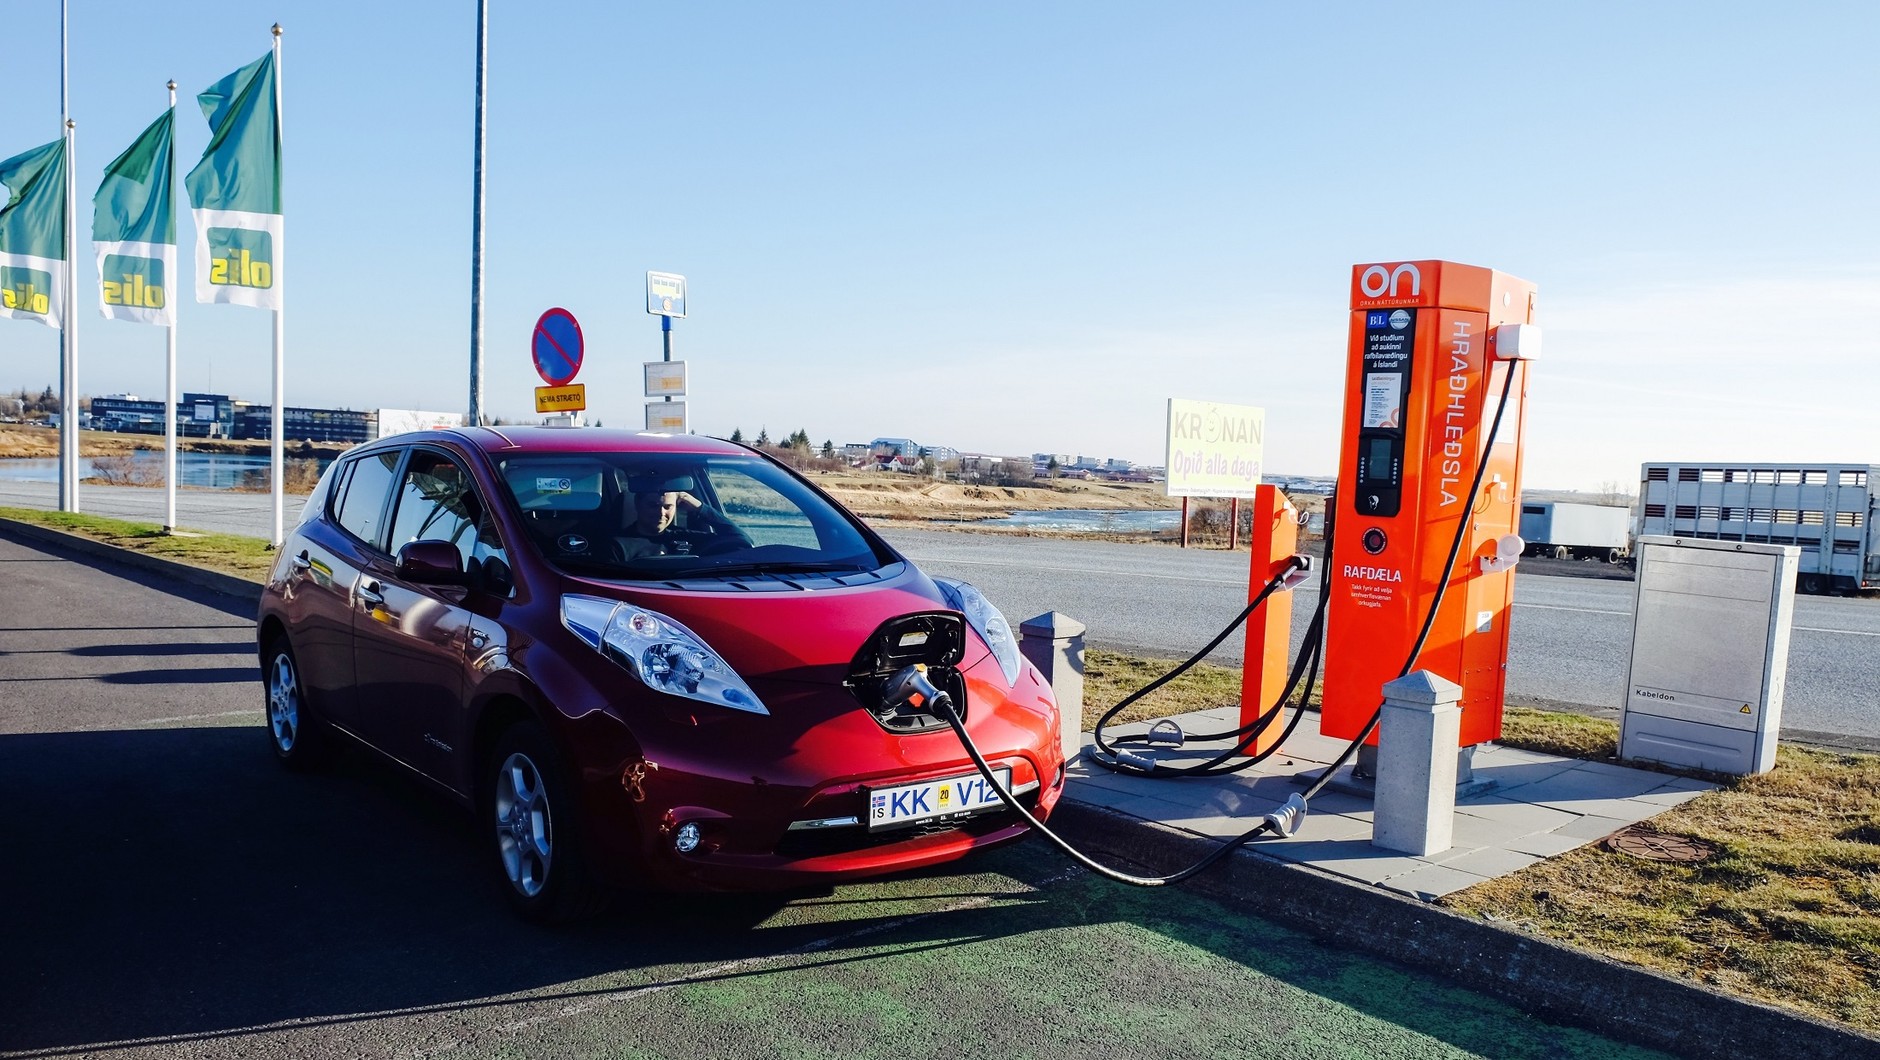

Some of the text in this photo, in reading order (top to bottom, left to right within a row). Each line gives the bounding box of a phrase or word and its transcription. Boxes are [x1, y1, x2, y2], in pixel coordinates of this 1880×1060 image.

[540, 395, 555, 404] NEMA
[1440, 321, 1471, 506] HRAÐHLEÐSLA
[1174, 449, 1259, 482] Opið alla daga
[1343, 565, 1402, 583] RAFDÆLA
[1636, 689, 1675, 701] Kabeldon
[940, 789, 949, 800] 20
[891, 787, 931, 818] KK
[872, 807, 885, 819] IS
